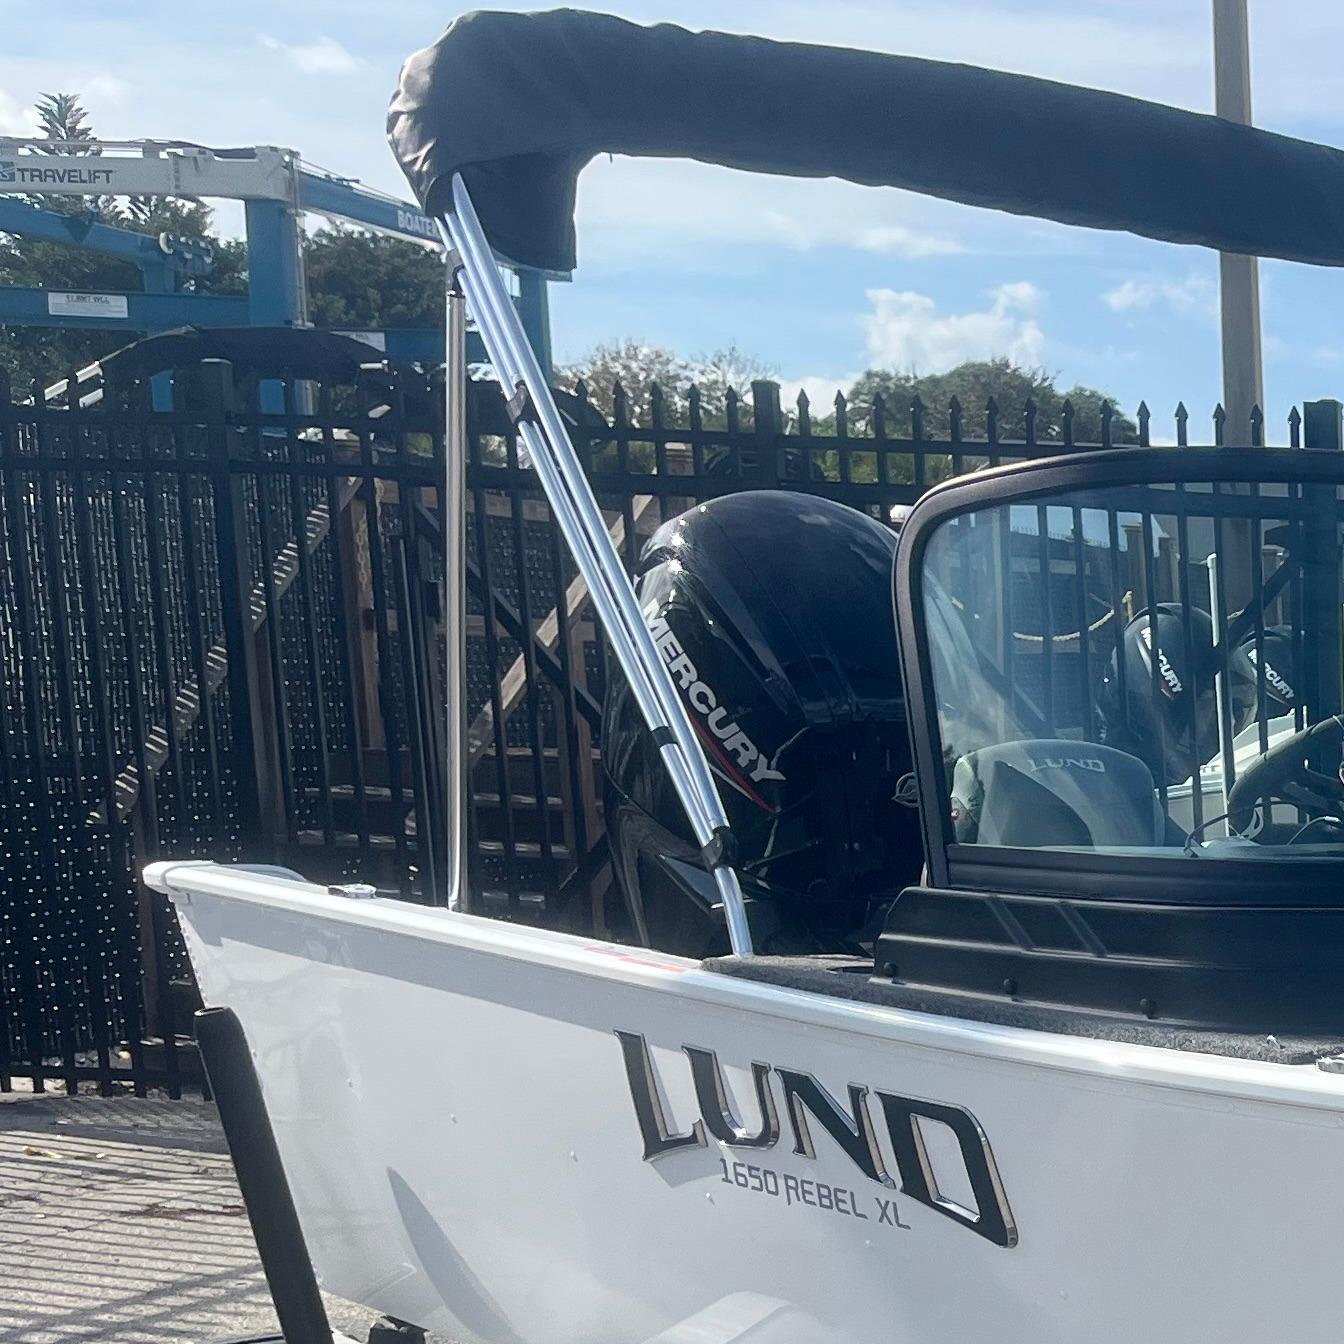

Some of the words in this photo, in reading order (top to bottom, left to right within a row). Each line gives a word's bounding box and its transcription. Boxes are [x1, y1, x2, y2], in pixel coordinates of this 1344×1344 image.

[16, 168, 113, 184] TRAVELIFT
[641, 598, 786, 782] MERCURY
[1027, 758, 1106, 773] LUND
[614, 1028, 1018, 1248] LUND
[718, 1157, 780, 1197] 1650
[784, 1172, 868, 1220] REBEL
[874, 1195, 912, 1230] XL
